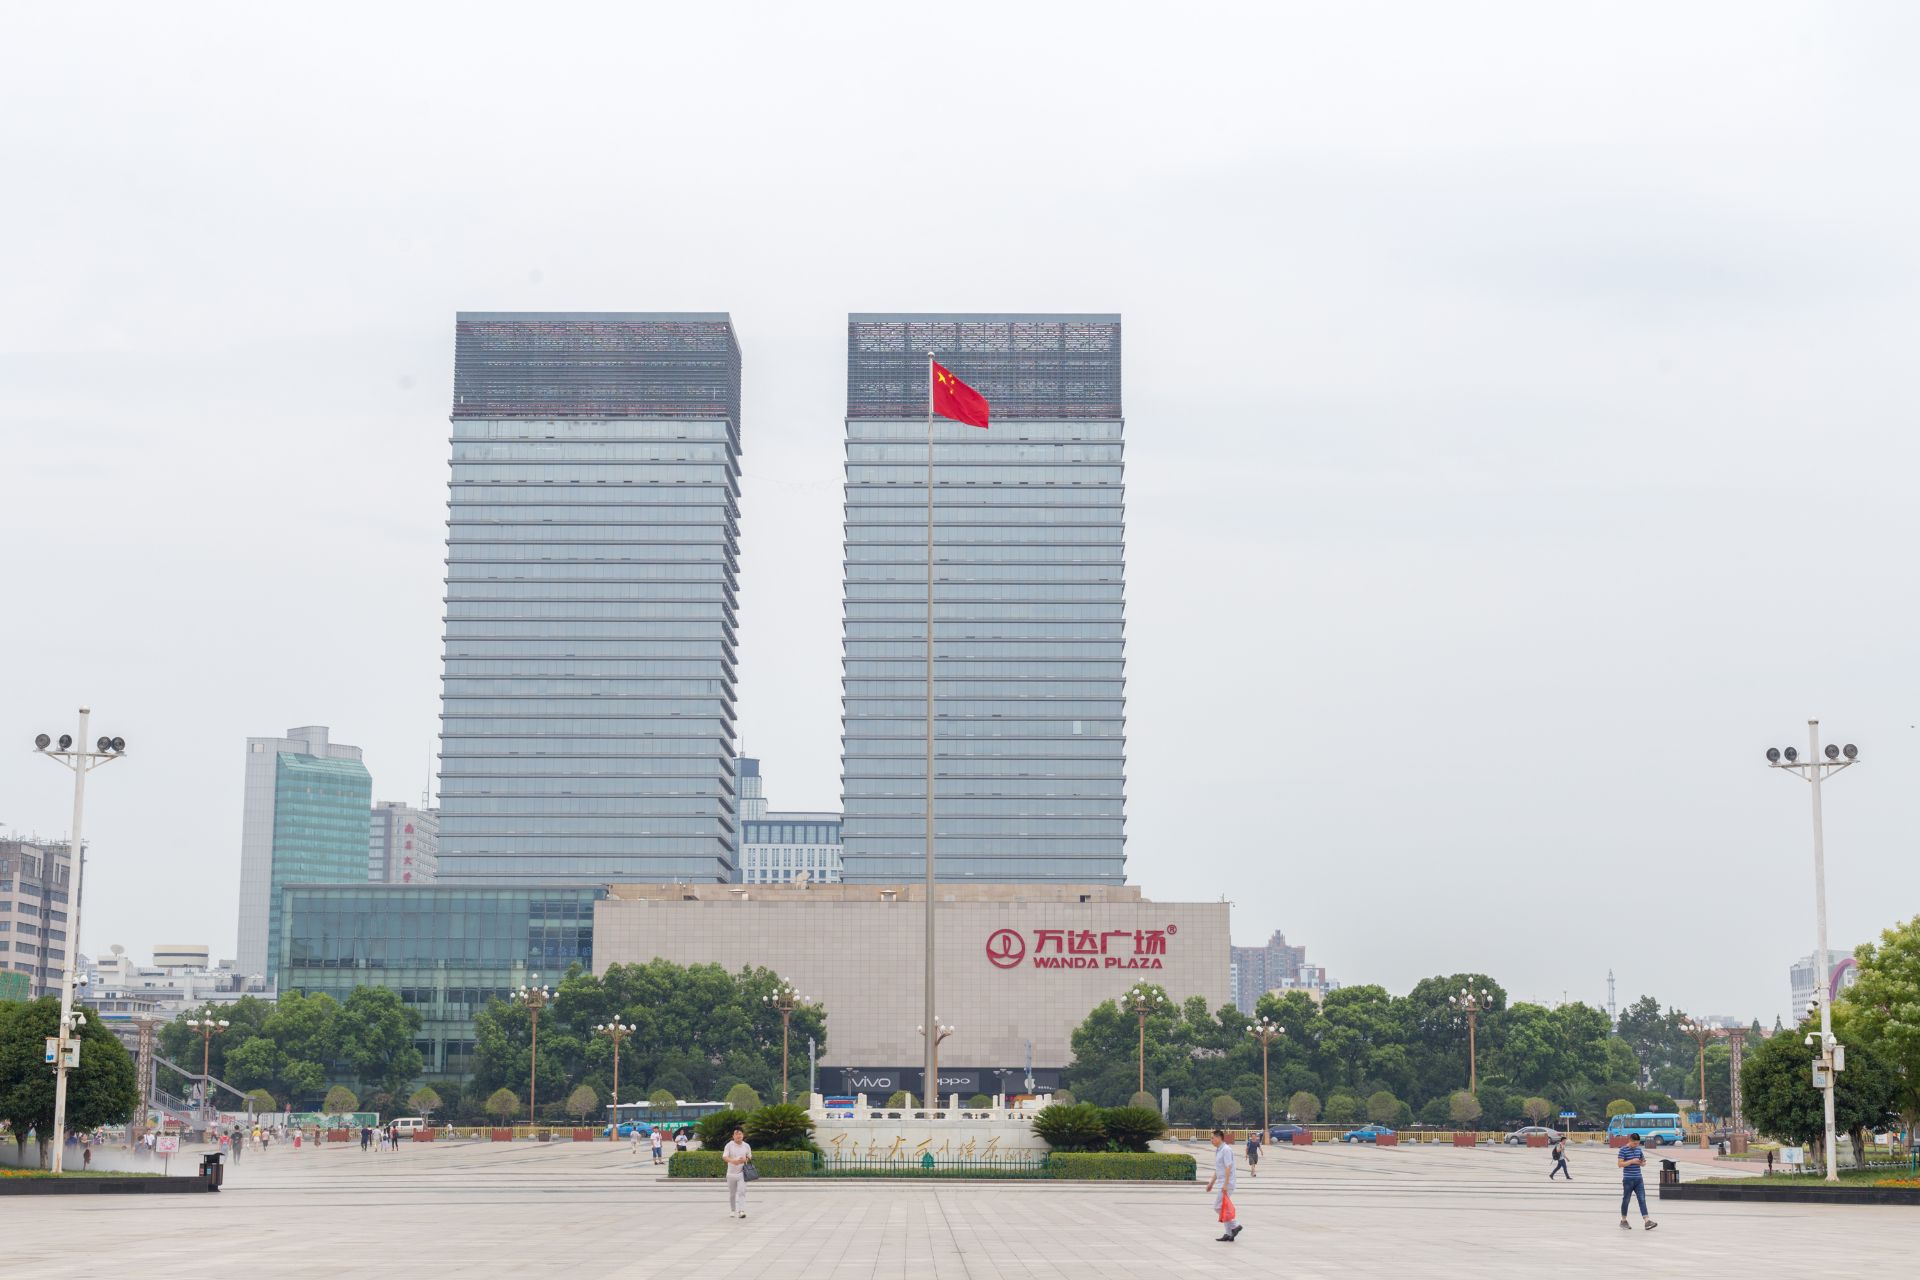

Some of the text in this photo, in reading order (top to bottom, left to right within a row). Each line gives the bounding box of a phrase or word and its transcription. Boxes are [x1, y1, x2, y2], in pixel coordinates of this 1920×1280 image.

[1033, 929, 1166, 955] 万达广场
[1033, 957, 1163, 969] WANDA PLAZA
